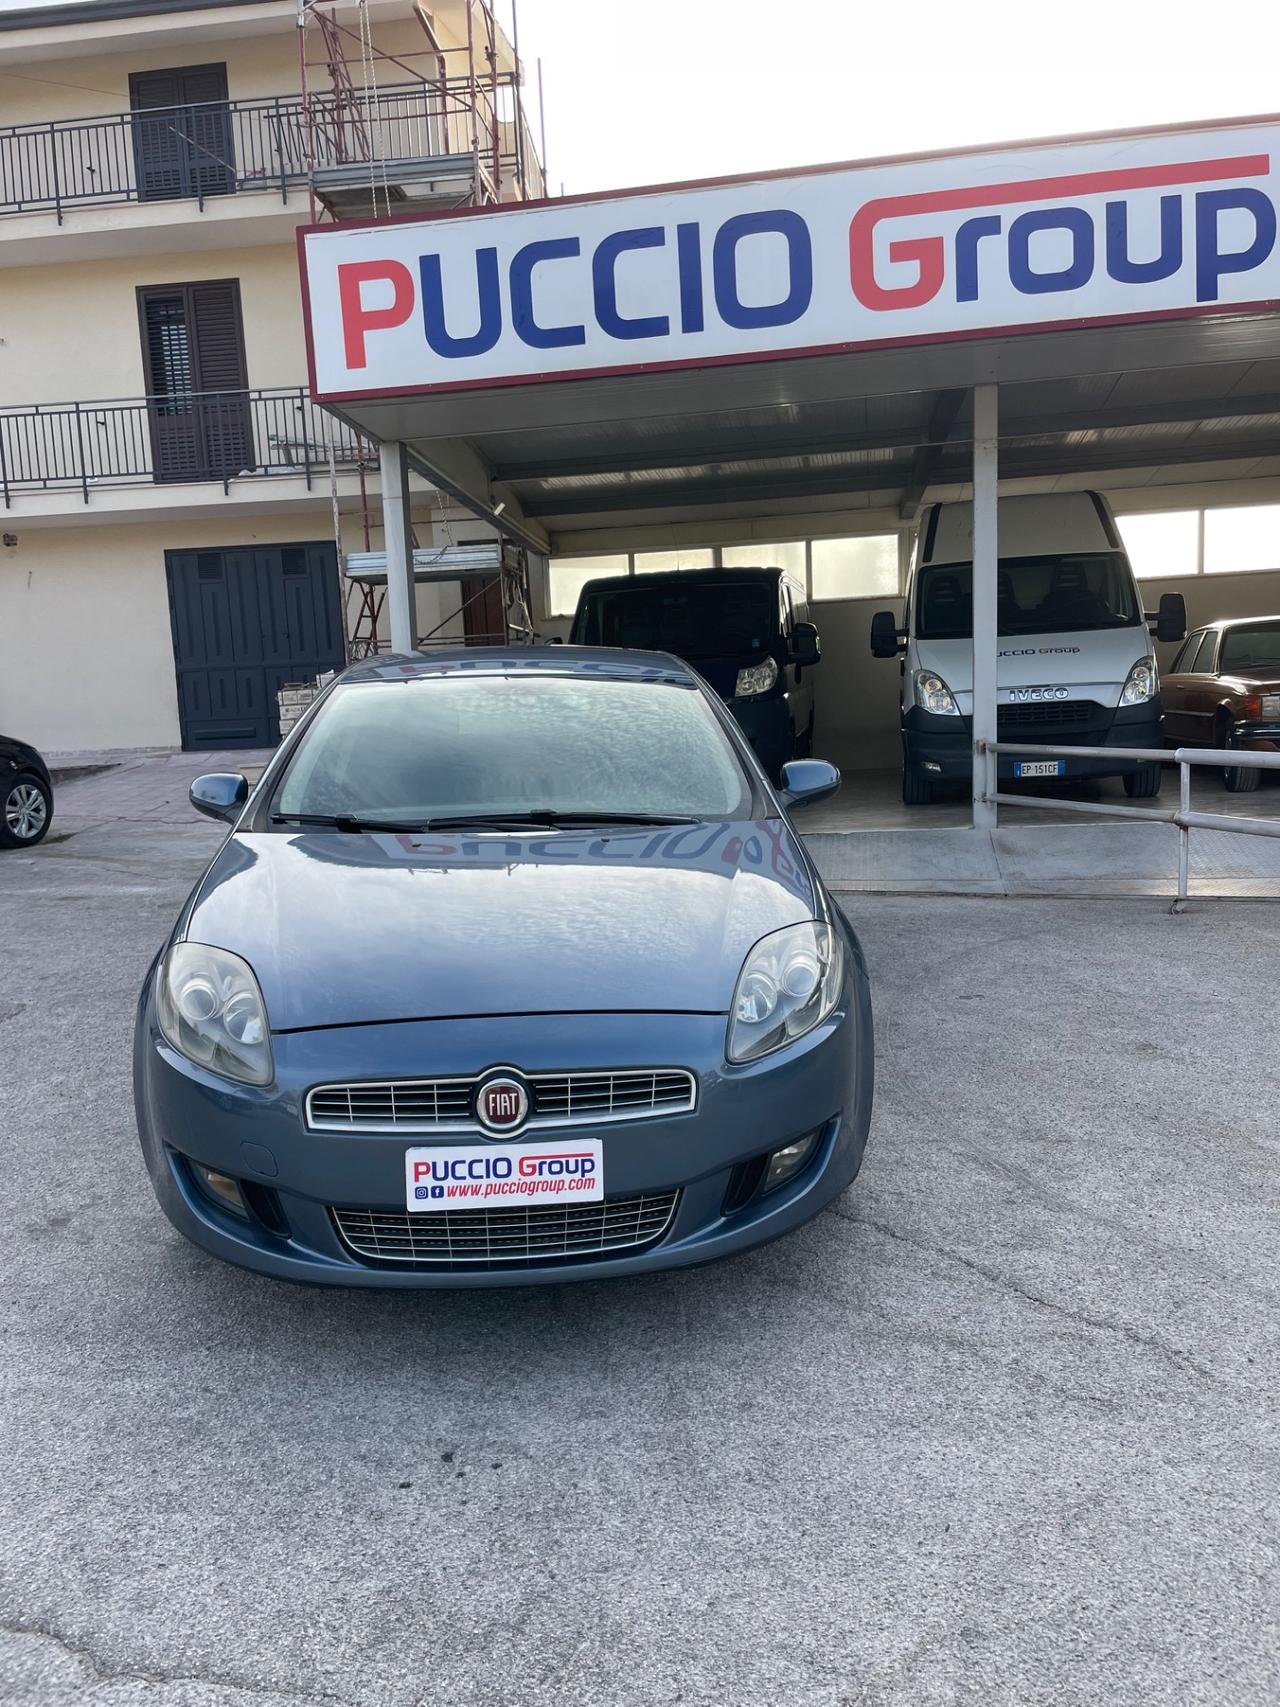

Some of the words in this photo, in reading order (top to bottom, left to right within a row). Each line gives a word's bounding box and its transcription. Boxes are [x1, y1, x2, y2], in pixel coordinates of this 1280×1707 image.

[337, 209, 814, 370] PUCCIO
[1009, 687, 1069, 702] IVECO
[488, 1092, 518, 1116] FIAT
[413, 1157, 513, 1183] PUCCIO
[447, 1177, 596, 1198] www.pucciogroup.com
